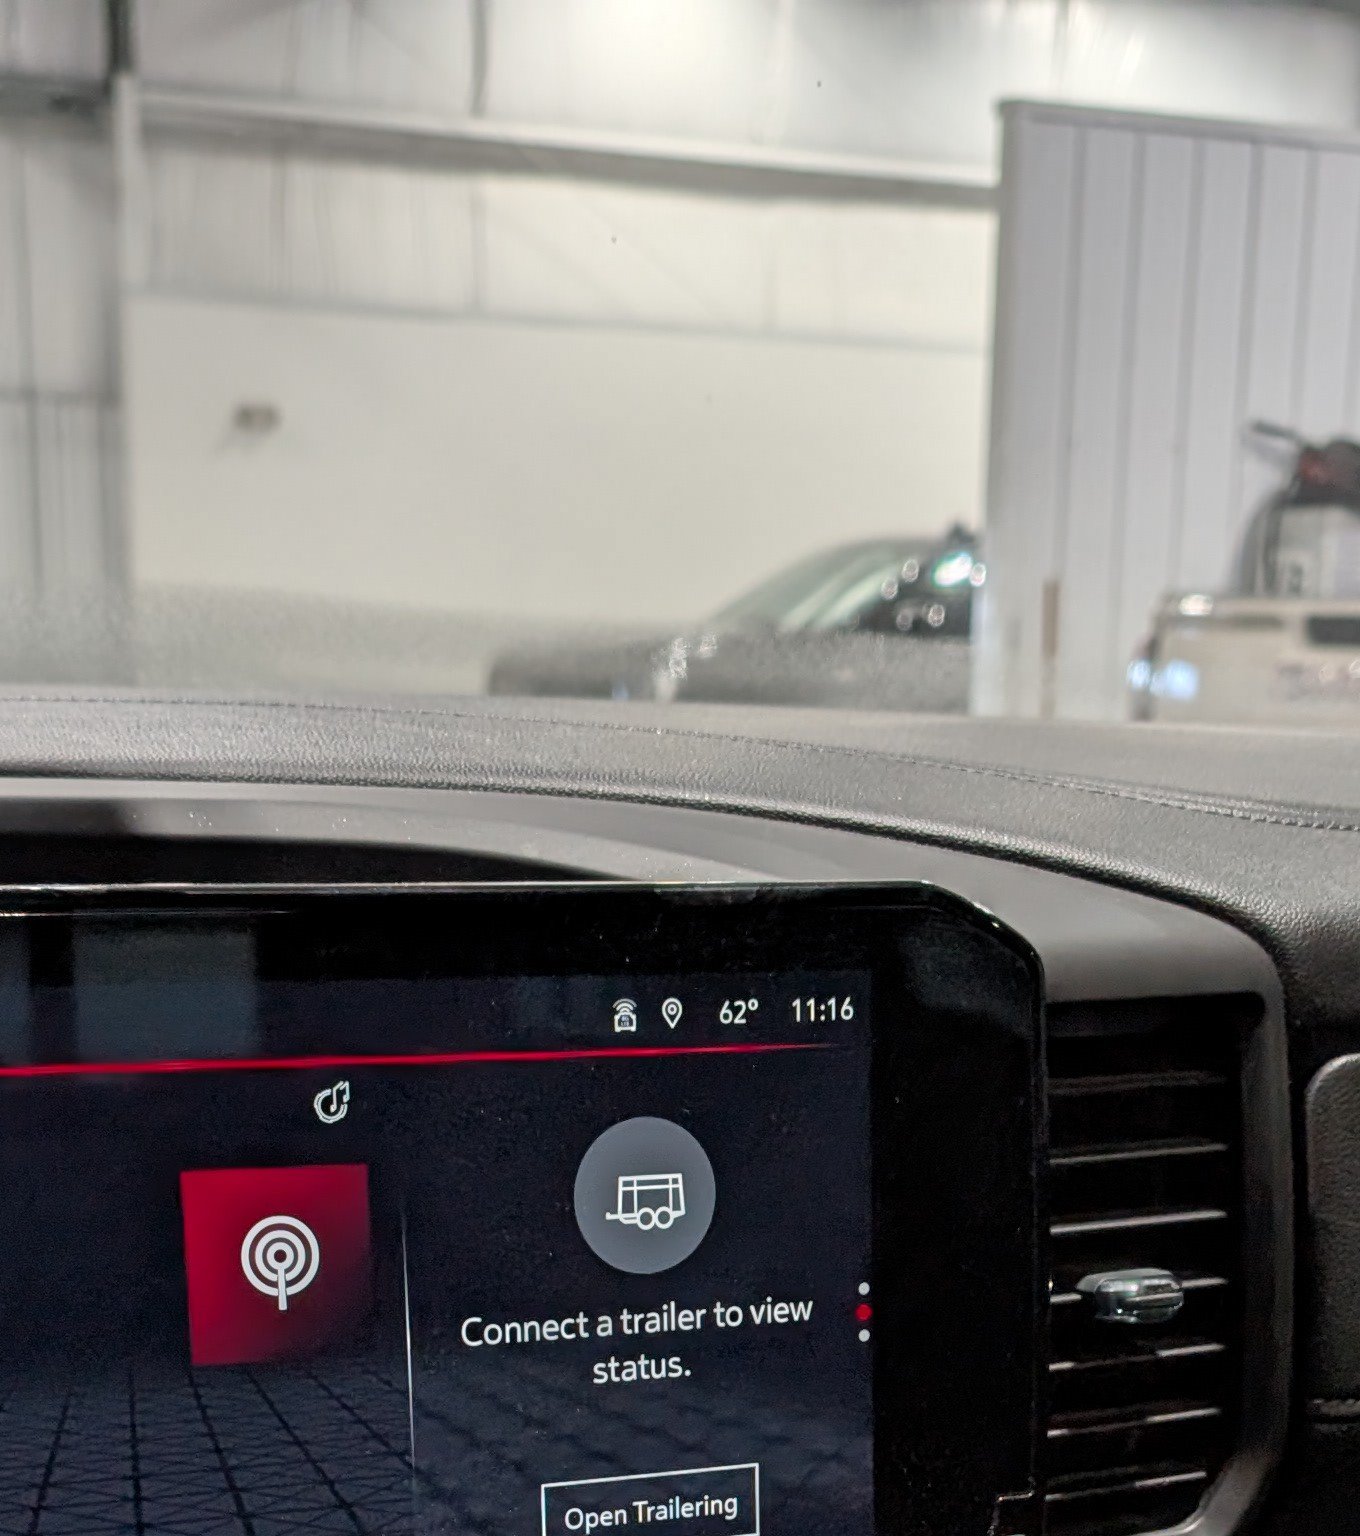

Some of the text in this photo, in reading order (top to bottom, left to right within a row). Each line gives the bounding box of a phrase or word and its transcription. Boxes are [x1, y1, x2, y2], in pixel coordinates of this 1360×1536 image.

[792, 996, 854, 1023] 11:16
[461, 1296, 814, 1347] Connect a trailer to view
[592, 1353, 692, 1384] status.
[564, 1494, 738, 1535] Open Trailering
